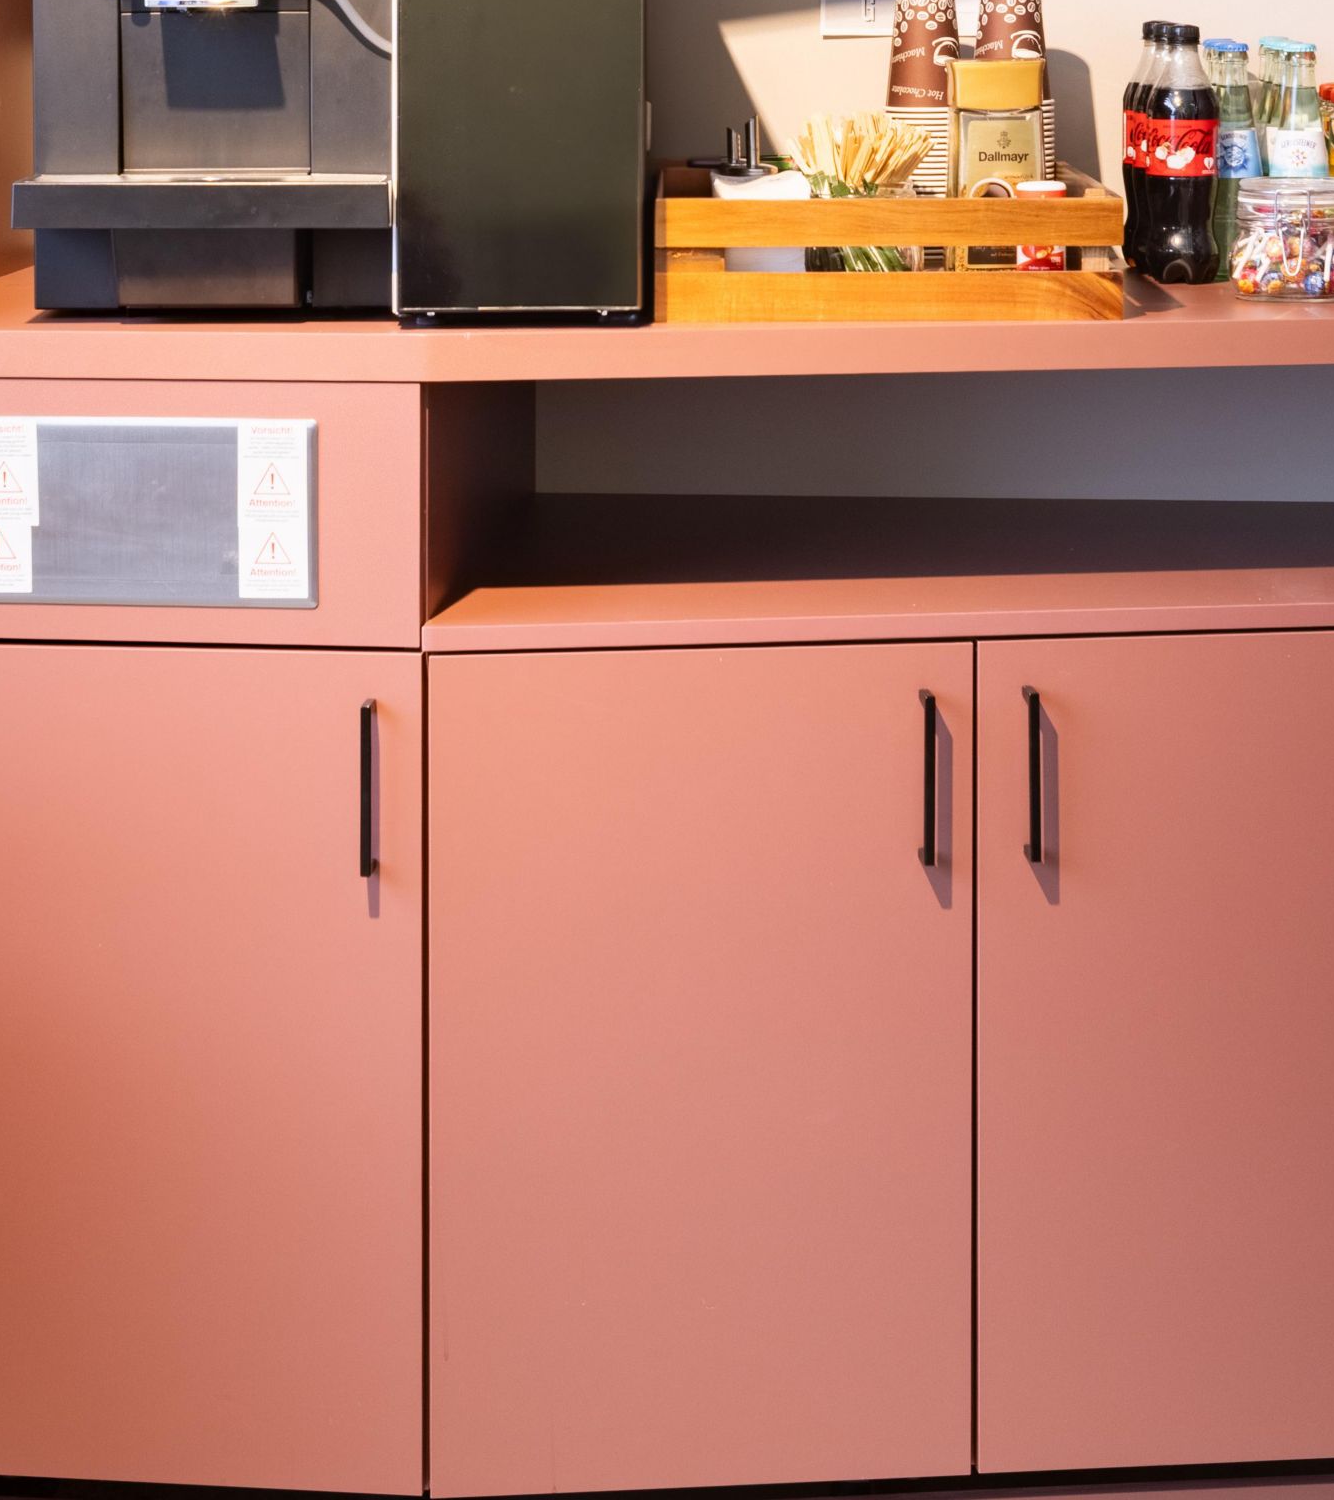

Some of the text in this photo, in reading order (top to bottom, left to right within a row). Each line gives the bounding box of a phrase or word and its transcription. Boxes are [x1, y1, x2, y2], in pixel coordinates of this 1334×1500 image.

[927, 90, 944, 100] Hot
[978, 151, 1030, 164] Dallmayr
[251, 426, 293, 435] Vorsicht!
[249, 498, 296, 508] Attention!
[250, 568, 297, 577] Attention!
